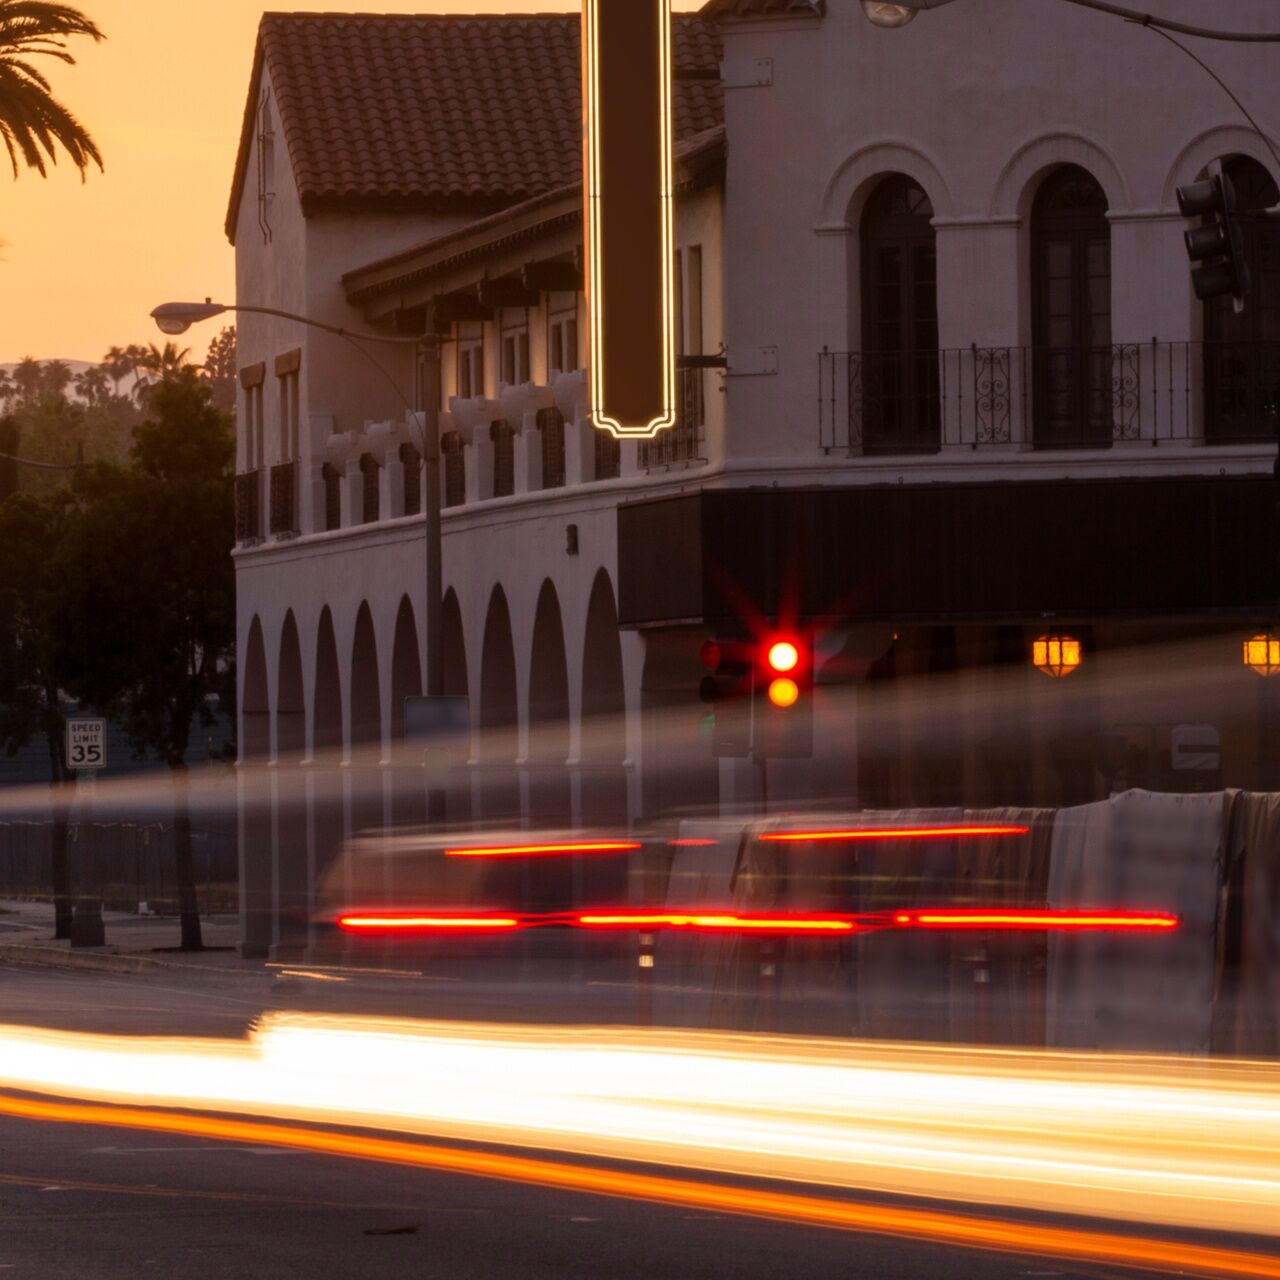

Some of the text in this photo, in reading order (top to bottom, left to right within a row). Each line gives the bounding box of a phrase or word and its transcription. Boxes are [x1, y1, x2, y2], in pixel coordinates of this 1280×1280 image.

[71, 723, 101, 732] SPEED
[73, 735, 99, 743] LIMIT
[72, 745, 101, 762] 35
